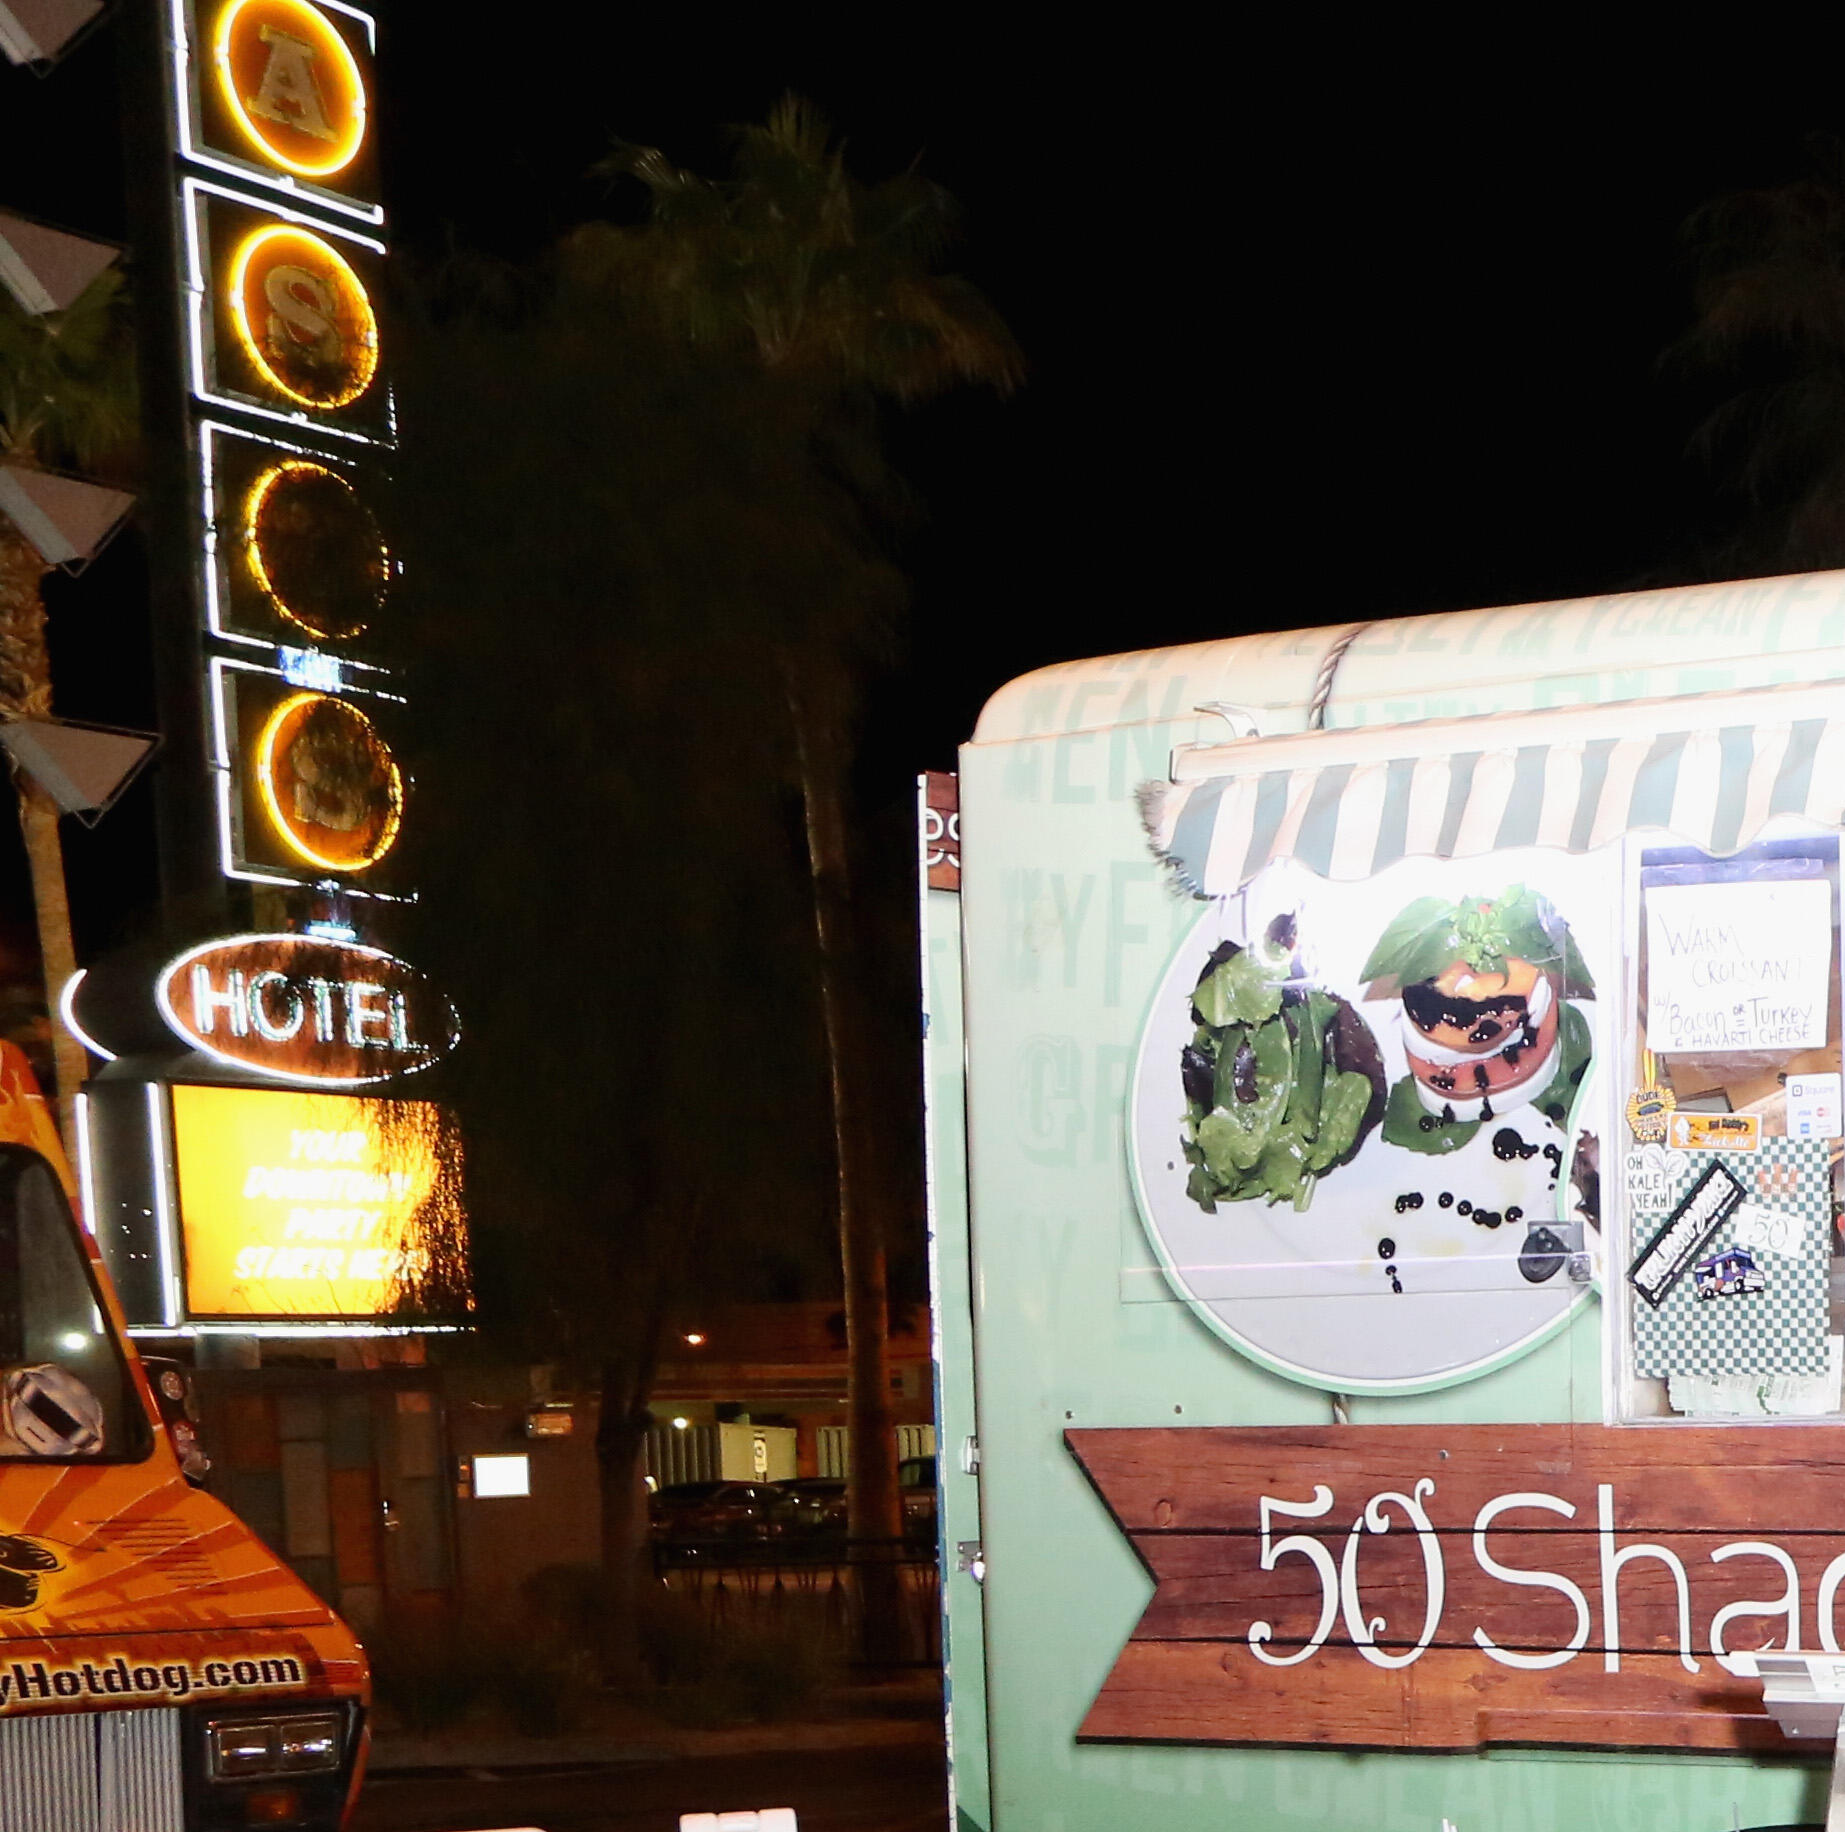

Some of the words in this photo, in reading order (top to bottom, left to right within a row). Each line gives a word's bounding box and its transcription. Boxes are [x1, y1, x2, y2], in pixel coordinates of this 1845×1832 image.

[191, 963, 430, 1051] HOTEL
[1670, 1003, 1727, 1035] Bacon
[1747, 996, 1813, 1028] Turkey
[1692, 1029, 1752, 1048] HAVARTI
[1758, 1024, 1810, 1044] CHEESE
[1627, 1155, 1643, 1169] OH
[1627, 1173, 1659, 1191] KALE
[1636, 1184, 1672, 1209] YEAH!
[1247, 1477, 1434, 1670] 50
